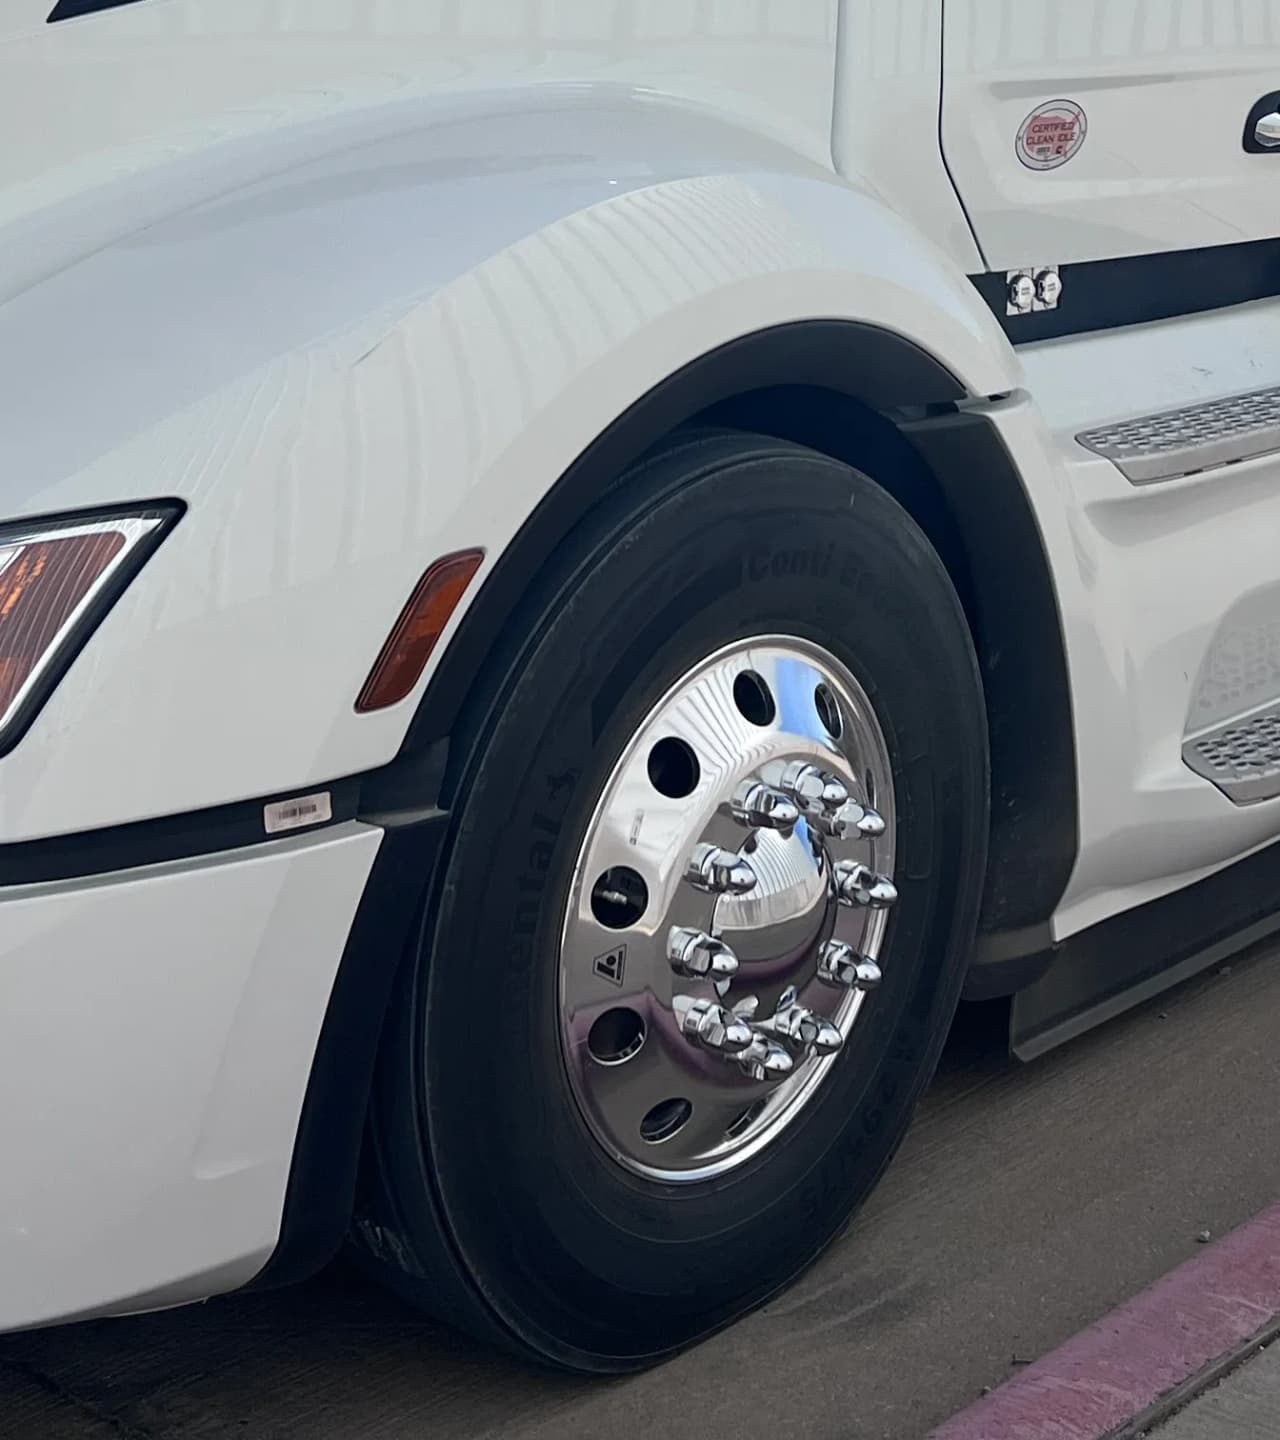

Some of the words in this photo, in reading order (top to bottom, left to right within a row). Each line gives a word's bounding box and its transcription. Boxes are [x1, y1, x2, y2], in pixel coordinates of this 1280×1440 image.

[1031, 121, 1075, 134] CERTIFIED
[1026, 134, 1055, 146] CLEAN
[1057, 132, 1077, 143] IDLE
